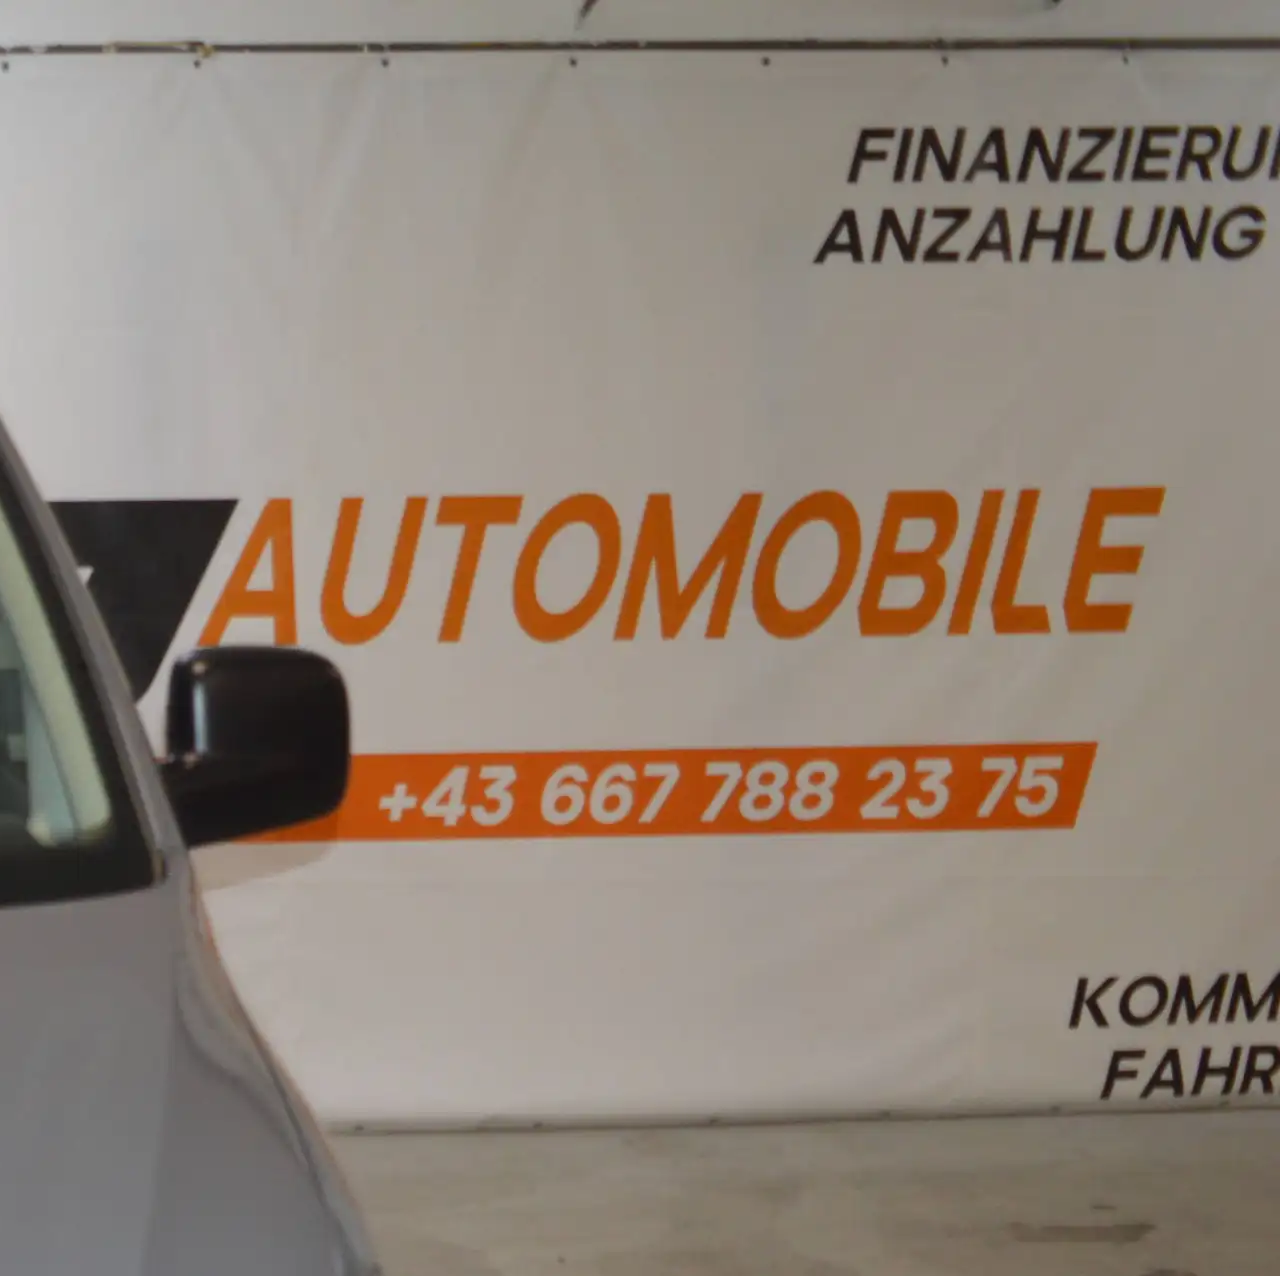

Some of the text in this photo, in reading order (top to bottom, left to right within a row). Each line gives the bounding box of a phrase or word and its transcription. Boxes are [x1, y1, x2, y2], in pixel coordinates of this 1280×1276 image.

[846, 125, 1280, 184] FINANZIERU
[813, 205, 1267, 264] ANZAHLUNG
[197, 486, 1166, 646] AUTOMOBILE
[378, 755, 1065, 827] +43 667 788 23 75
